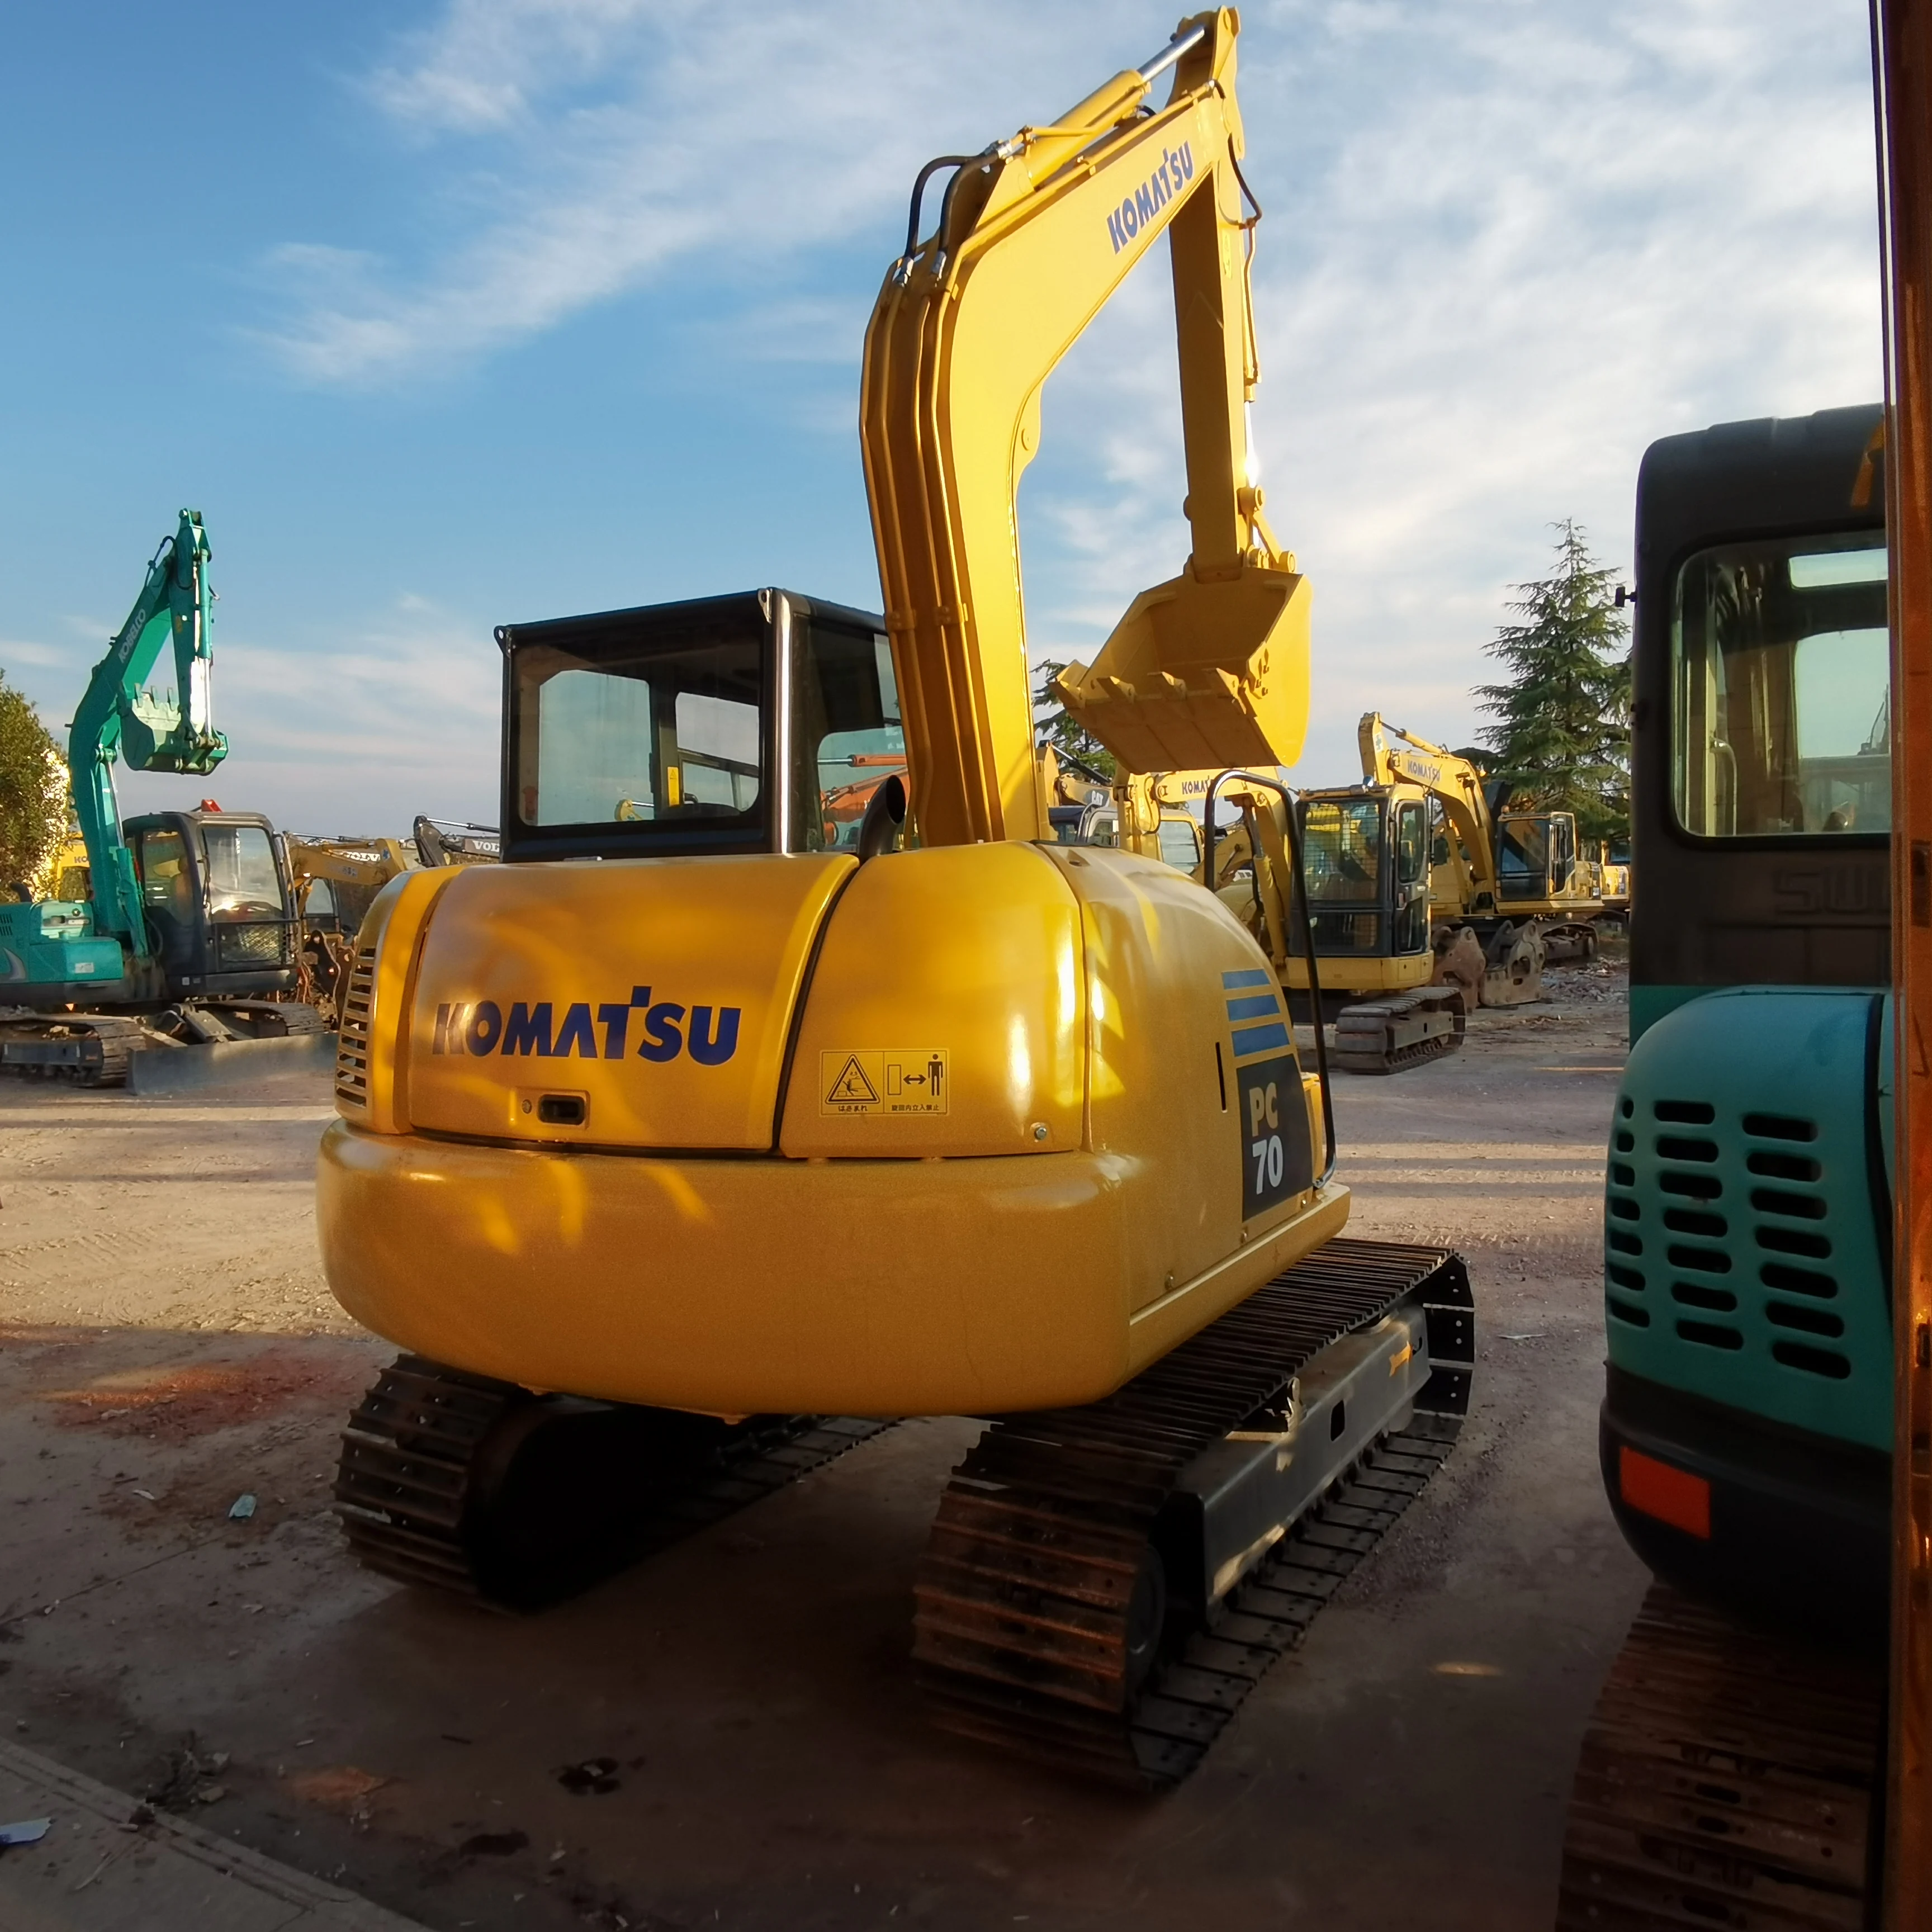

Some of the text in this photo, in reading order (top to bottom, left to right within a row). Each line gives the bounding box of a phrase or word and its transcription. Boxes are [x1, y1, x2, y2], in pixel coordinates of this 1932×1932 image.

[1106, 140, 1193, 255] KOMATSU
[118, 608, 145, 664] KOBELCO
[1092, 790, 1103, 806] CAT
[1408, 759, 1441, 782] KOMATSU
[472, 840, 500, 852] VOL
[1771, 866, 1891, 915] SU
[432, 986, 741, 1066] KOMATSU
[1249, 1082, 1278, 1137] PC
[1252, 1135, 1283, 1195] 70
